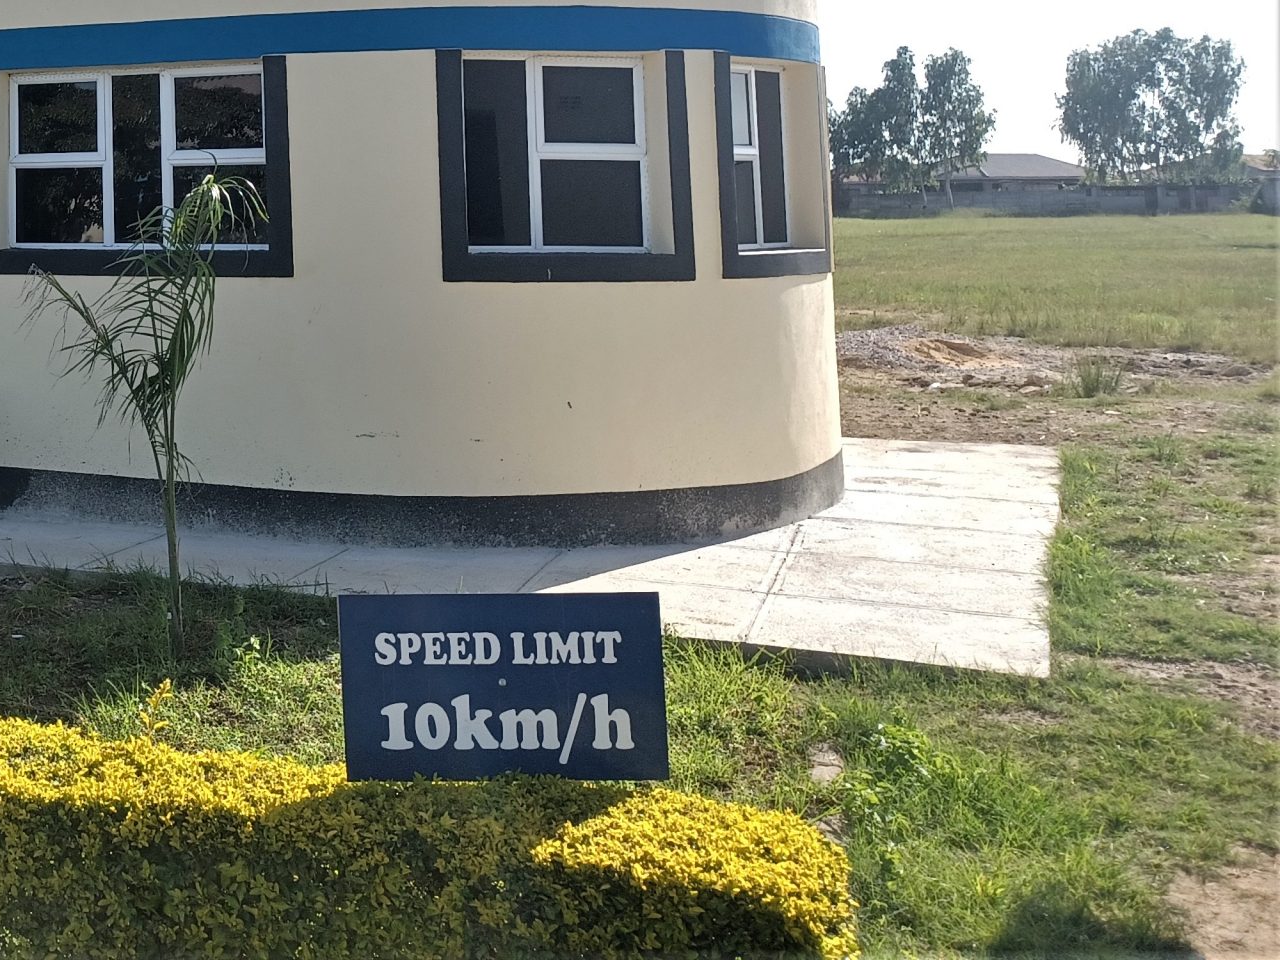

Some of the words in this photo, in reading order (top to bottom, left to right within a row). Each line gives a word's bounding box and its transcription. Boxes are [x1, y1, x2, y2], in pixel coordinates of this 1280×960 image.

[374, 631, 501, 665] SPEED
[510, 630, 622, 664] LIMIT
[380, 692, 635, 765] 10km/h
